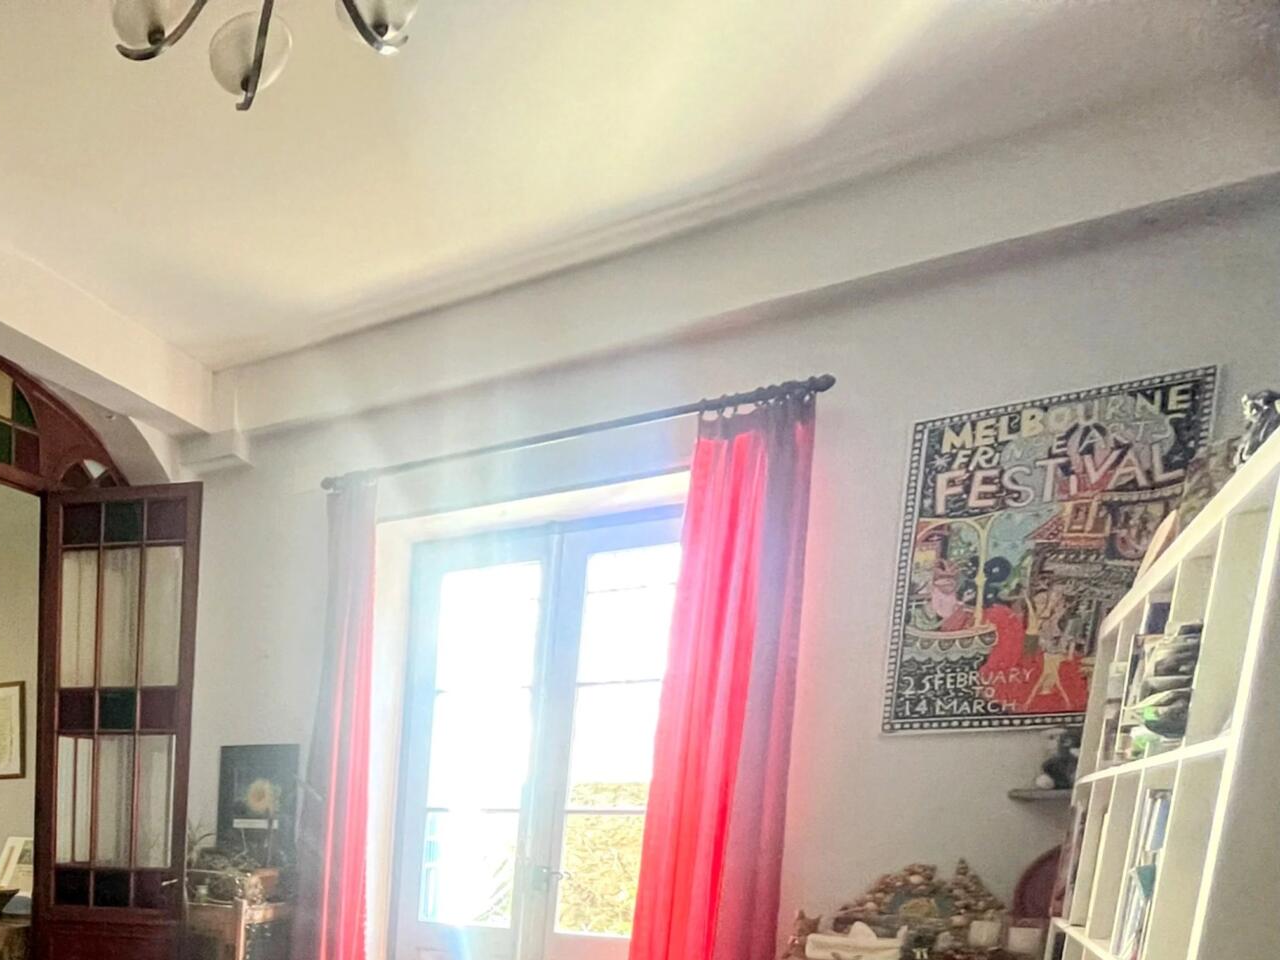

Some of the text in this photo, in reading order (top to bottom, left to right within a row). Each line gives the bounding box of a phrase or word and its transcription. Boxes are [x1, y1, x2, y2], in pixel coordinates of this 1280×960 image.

[942, 384, 1195, 454] MELBOURNE
[1078, 413, 1186, 452] ARTS
[901, 667, 1033, 695] 25 FEBRUARY
[972, 685, 996, 699] TO
[904, 699, 1018, 716] 14 MARCH
